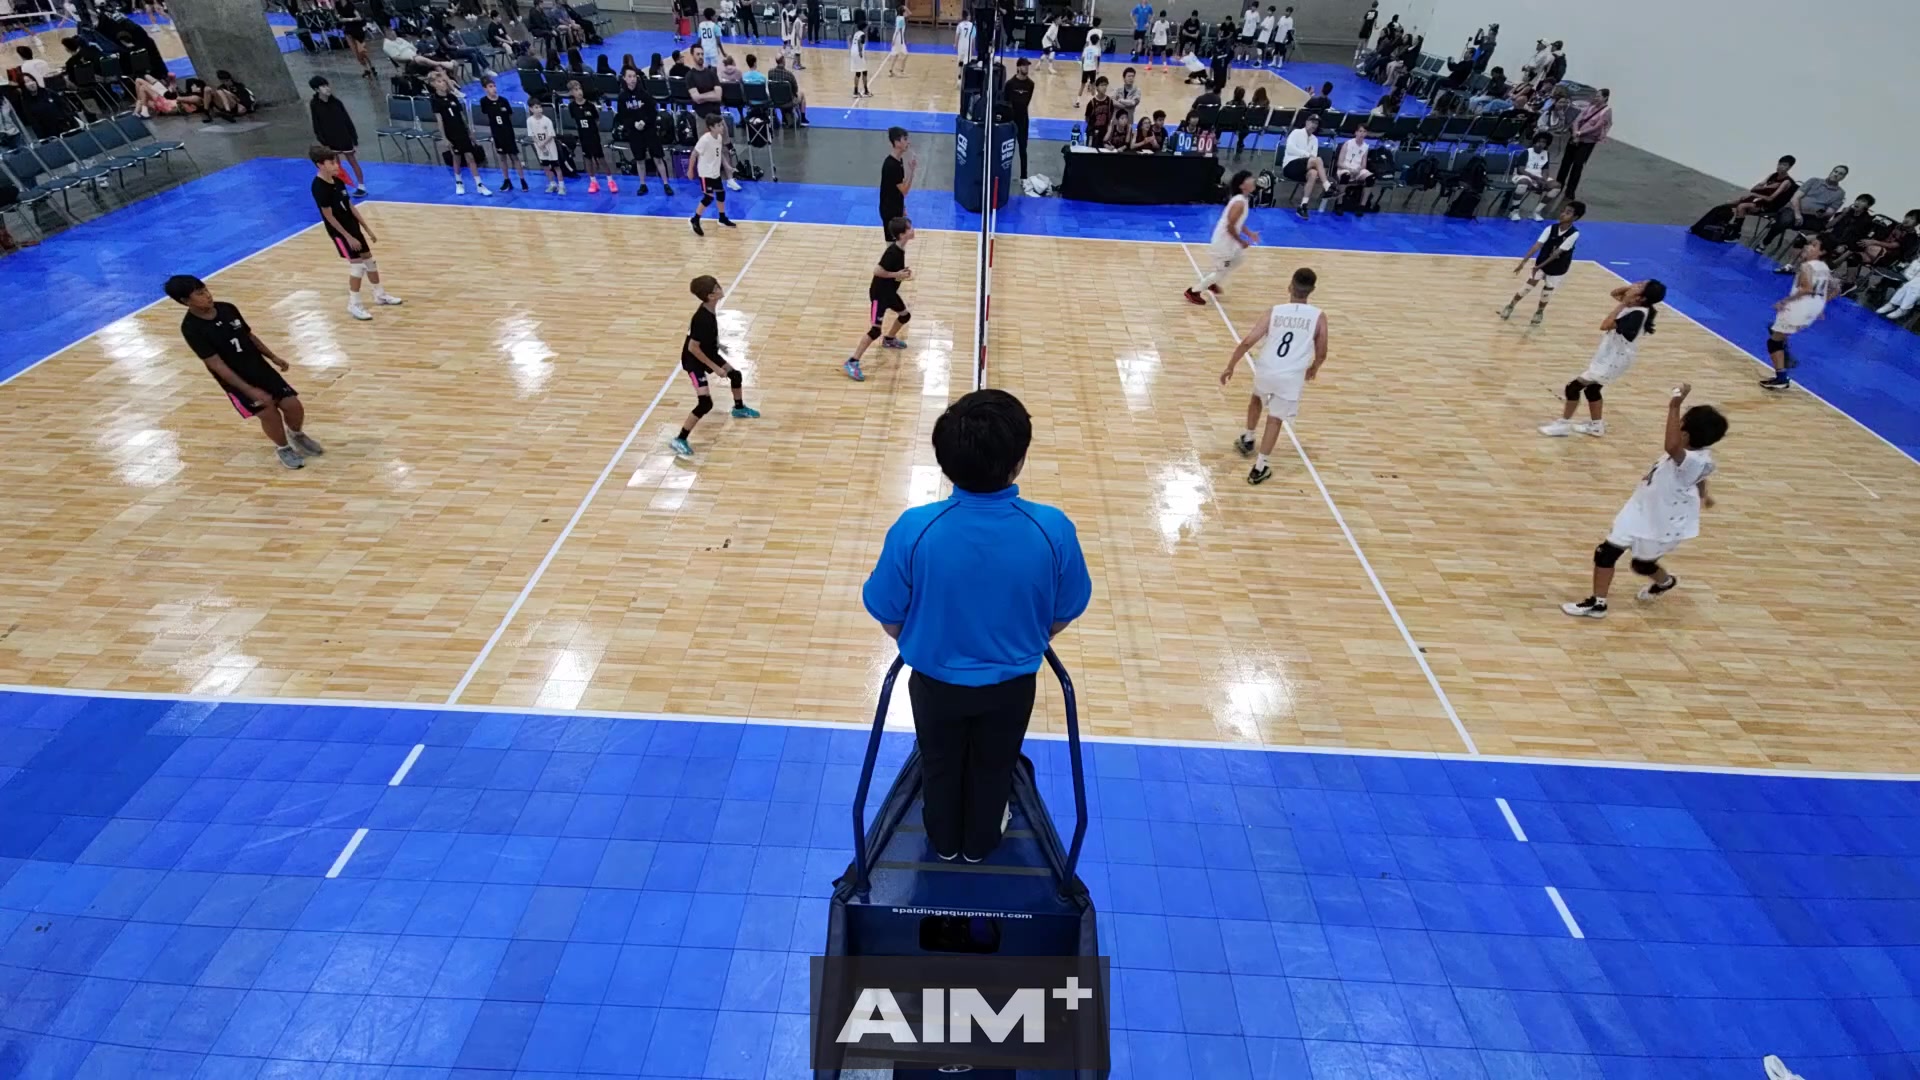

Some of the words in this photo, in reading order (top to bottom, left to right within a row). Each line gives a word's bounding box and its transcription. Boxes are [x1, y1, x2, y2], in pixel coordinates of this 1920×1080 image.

[702, 27, 712, 39] 20
[964, 27, 969, 38] 7
[580, 119, 589, 128] 15
[1198, 137, 1213, 152] 00
[1273, 315, 1311, 331] ROCKSTAR
[230, 338, 243, 352] 7
[1277, 331, 1293, 357] 8
[892, 907, 1033, 919] spaldingequipment.com
